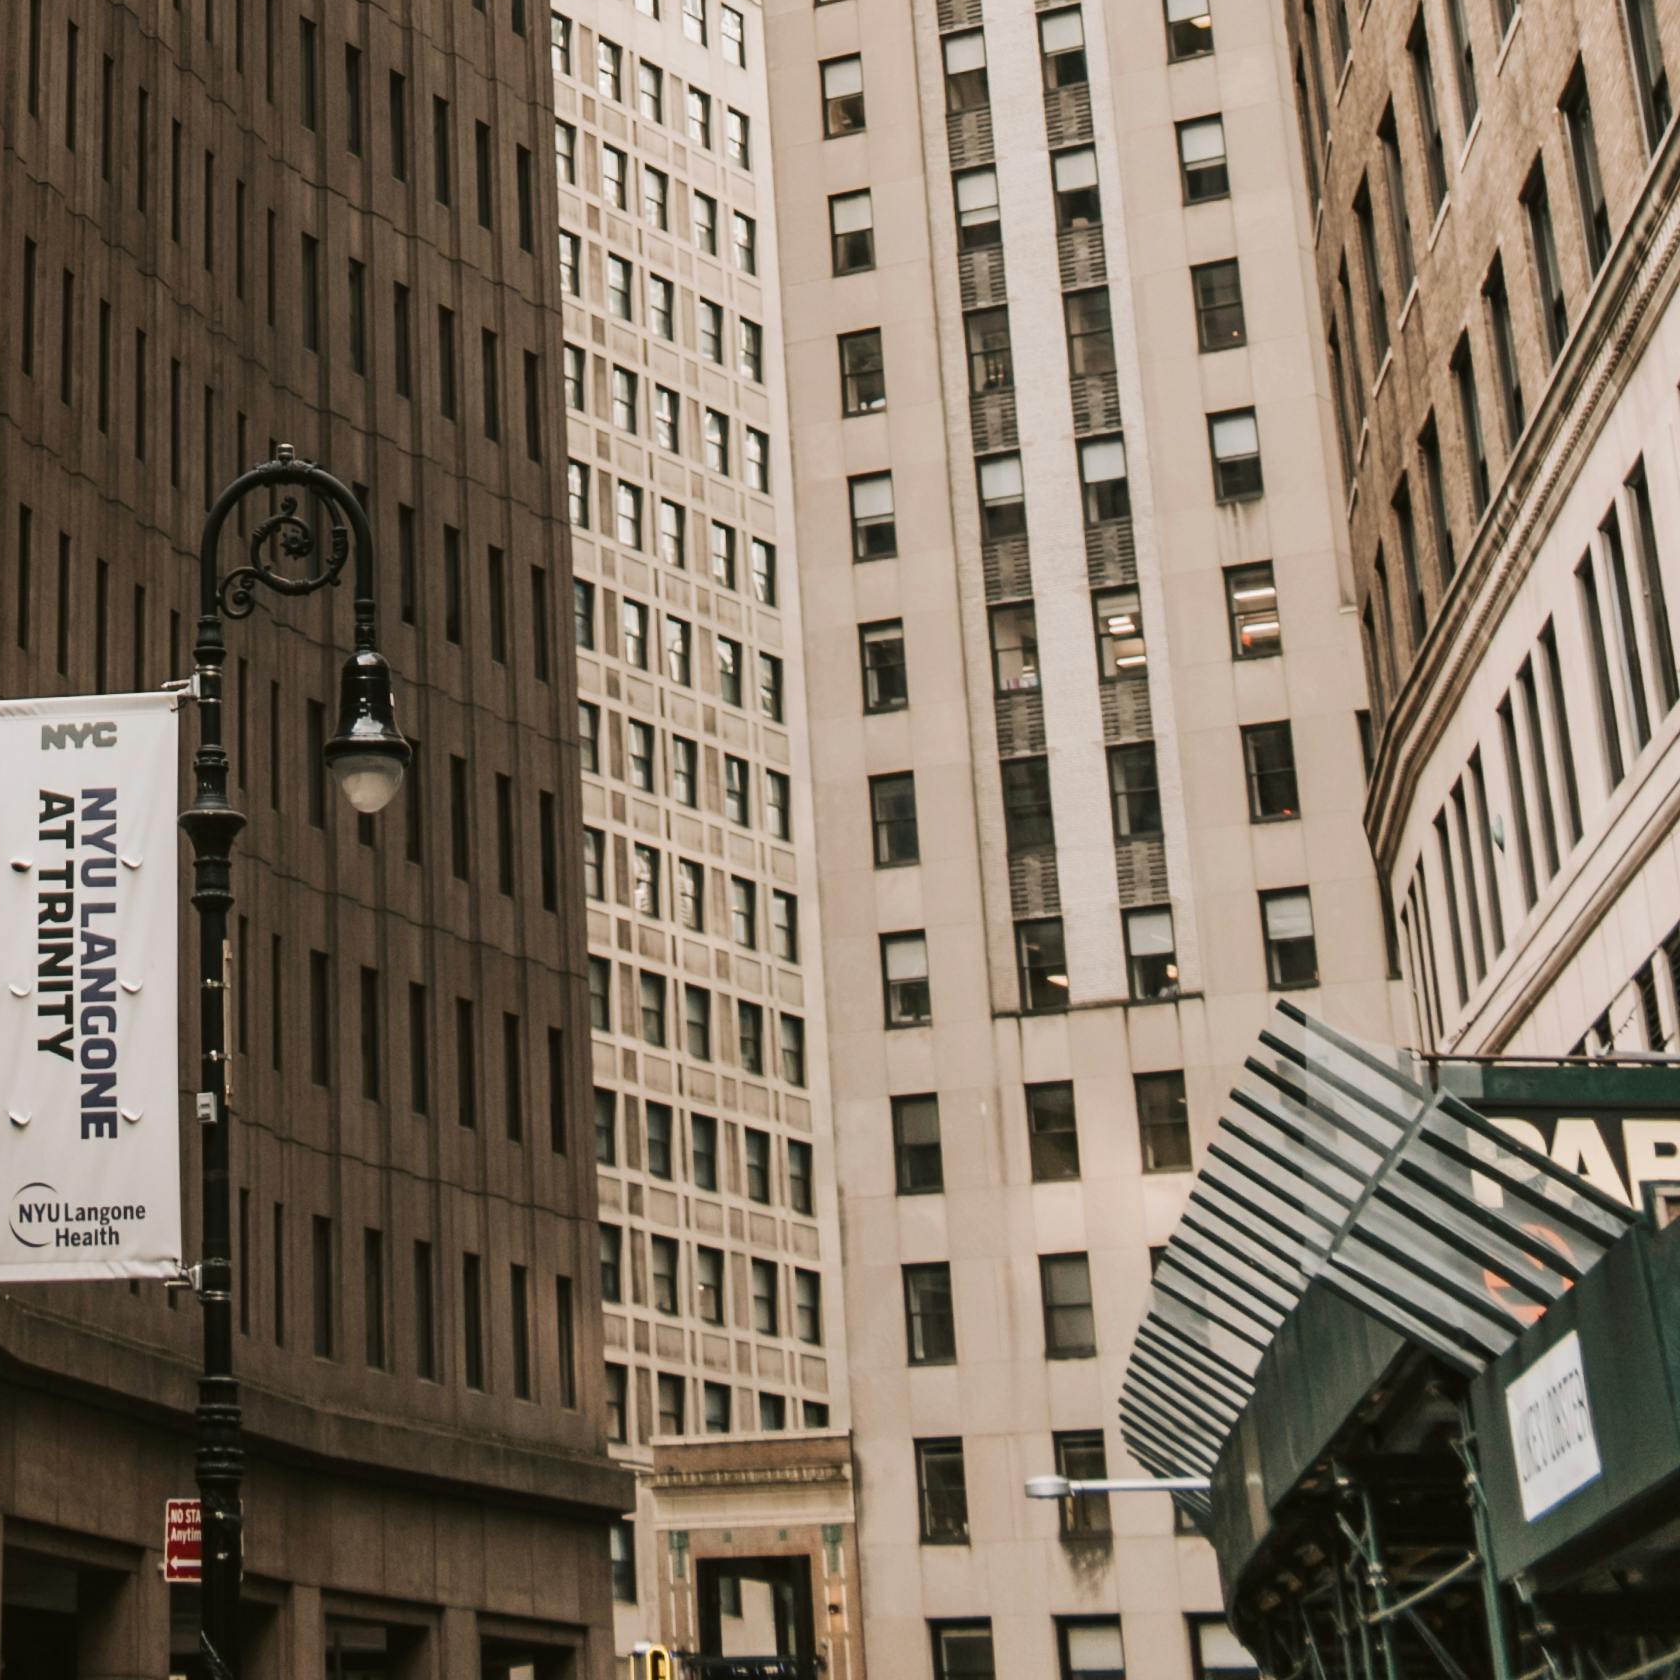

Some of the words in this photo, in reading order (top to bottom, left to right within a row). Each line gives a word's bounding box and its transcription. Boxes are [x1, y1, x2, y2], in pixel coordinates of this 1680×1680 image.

[41, 722, 117, 750] NYC
[38, 789, 75, 849] AT
[80, 788, 117, 887] NYU
[37, 860, 74, 1062] TRINITY
[80, 902, 118, 1139] LANGONE
[19, 1203, 60, 1223] NYU
[64, 1202, 146, 1225] Langone
[55, 1226, 120, 1247] Health
[170, 1508, 184, 1523] NO
[170, 1526, 202, 1544] Anytim
